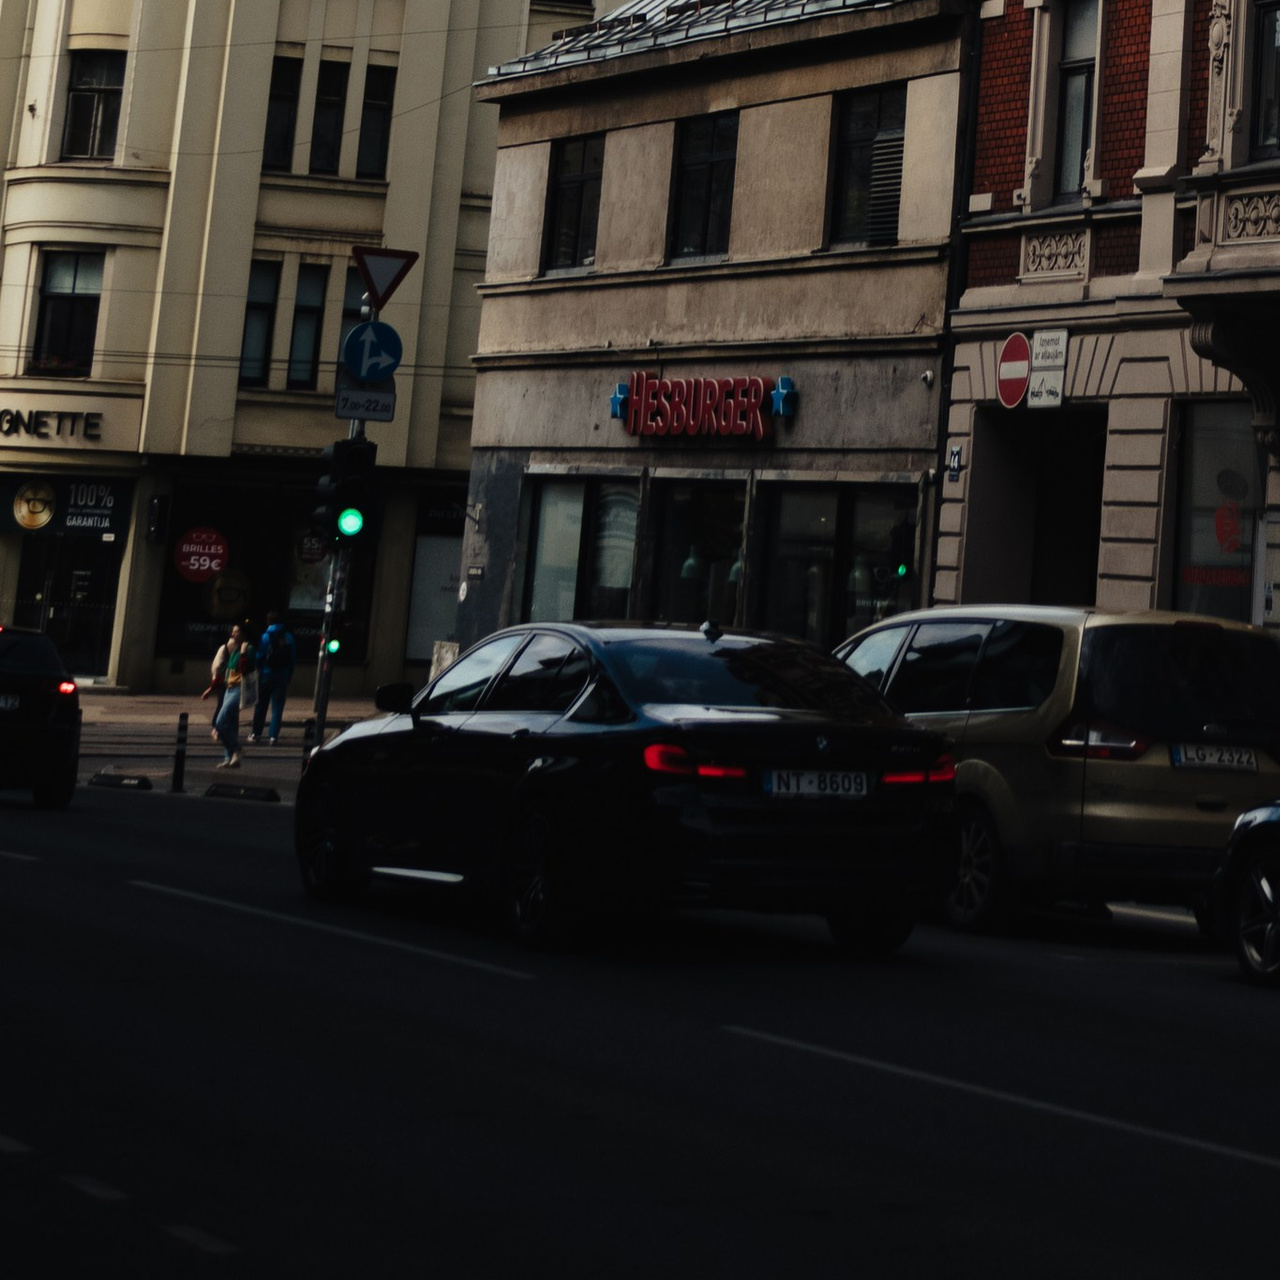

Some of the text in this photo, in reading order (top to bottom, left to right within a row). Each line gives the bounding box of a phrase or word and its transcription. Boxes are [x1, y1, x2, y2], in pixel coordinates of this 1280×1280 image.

[627, 371, 765, 441] HESBURGER
[69, 483, 115, 508] 100%
[66, 515, 110, 528] GARANTIJA
[182, 544, 223, 554] BRILLES
[189, 555, 222, 571] 59€
